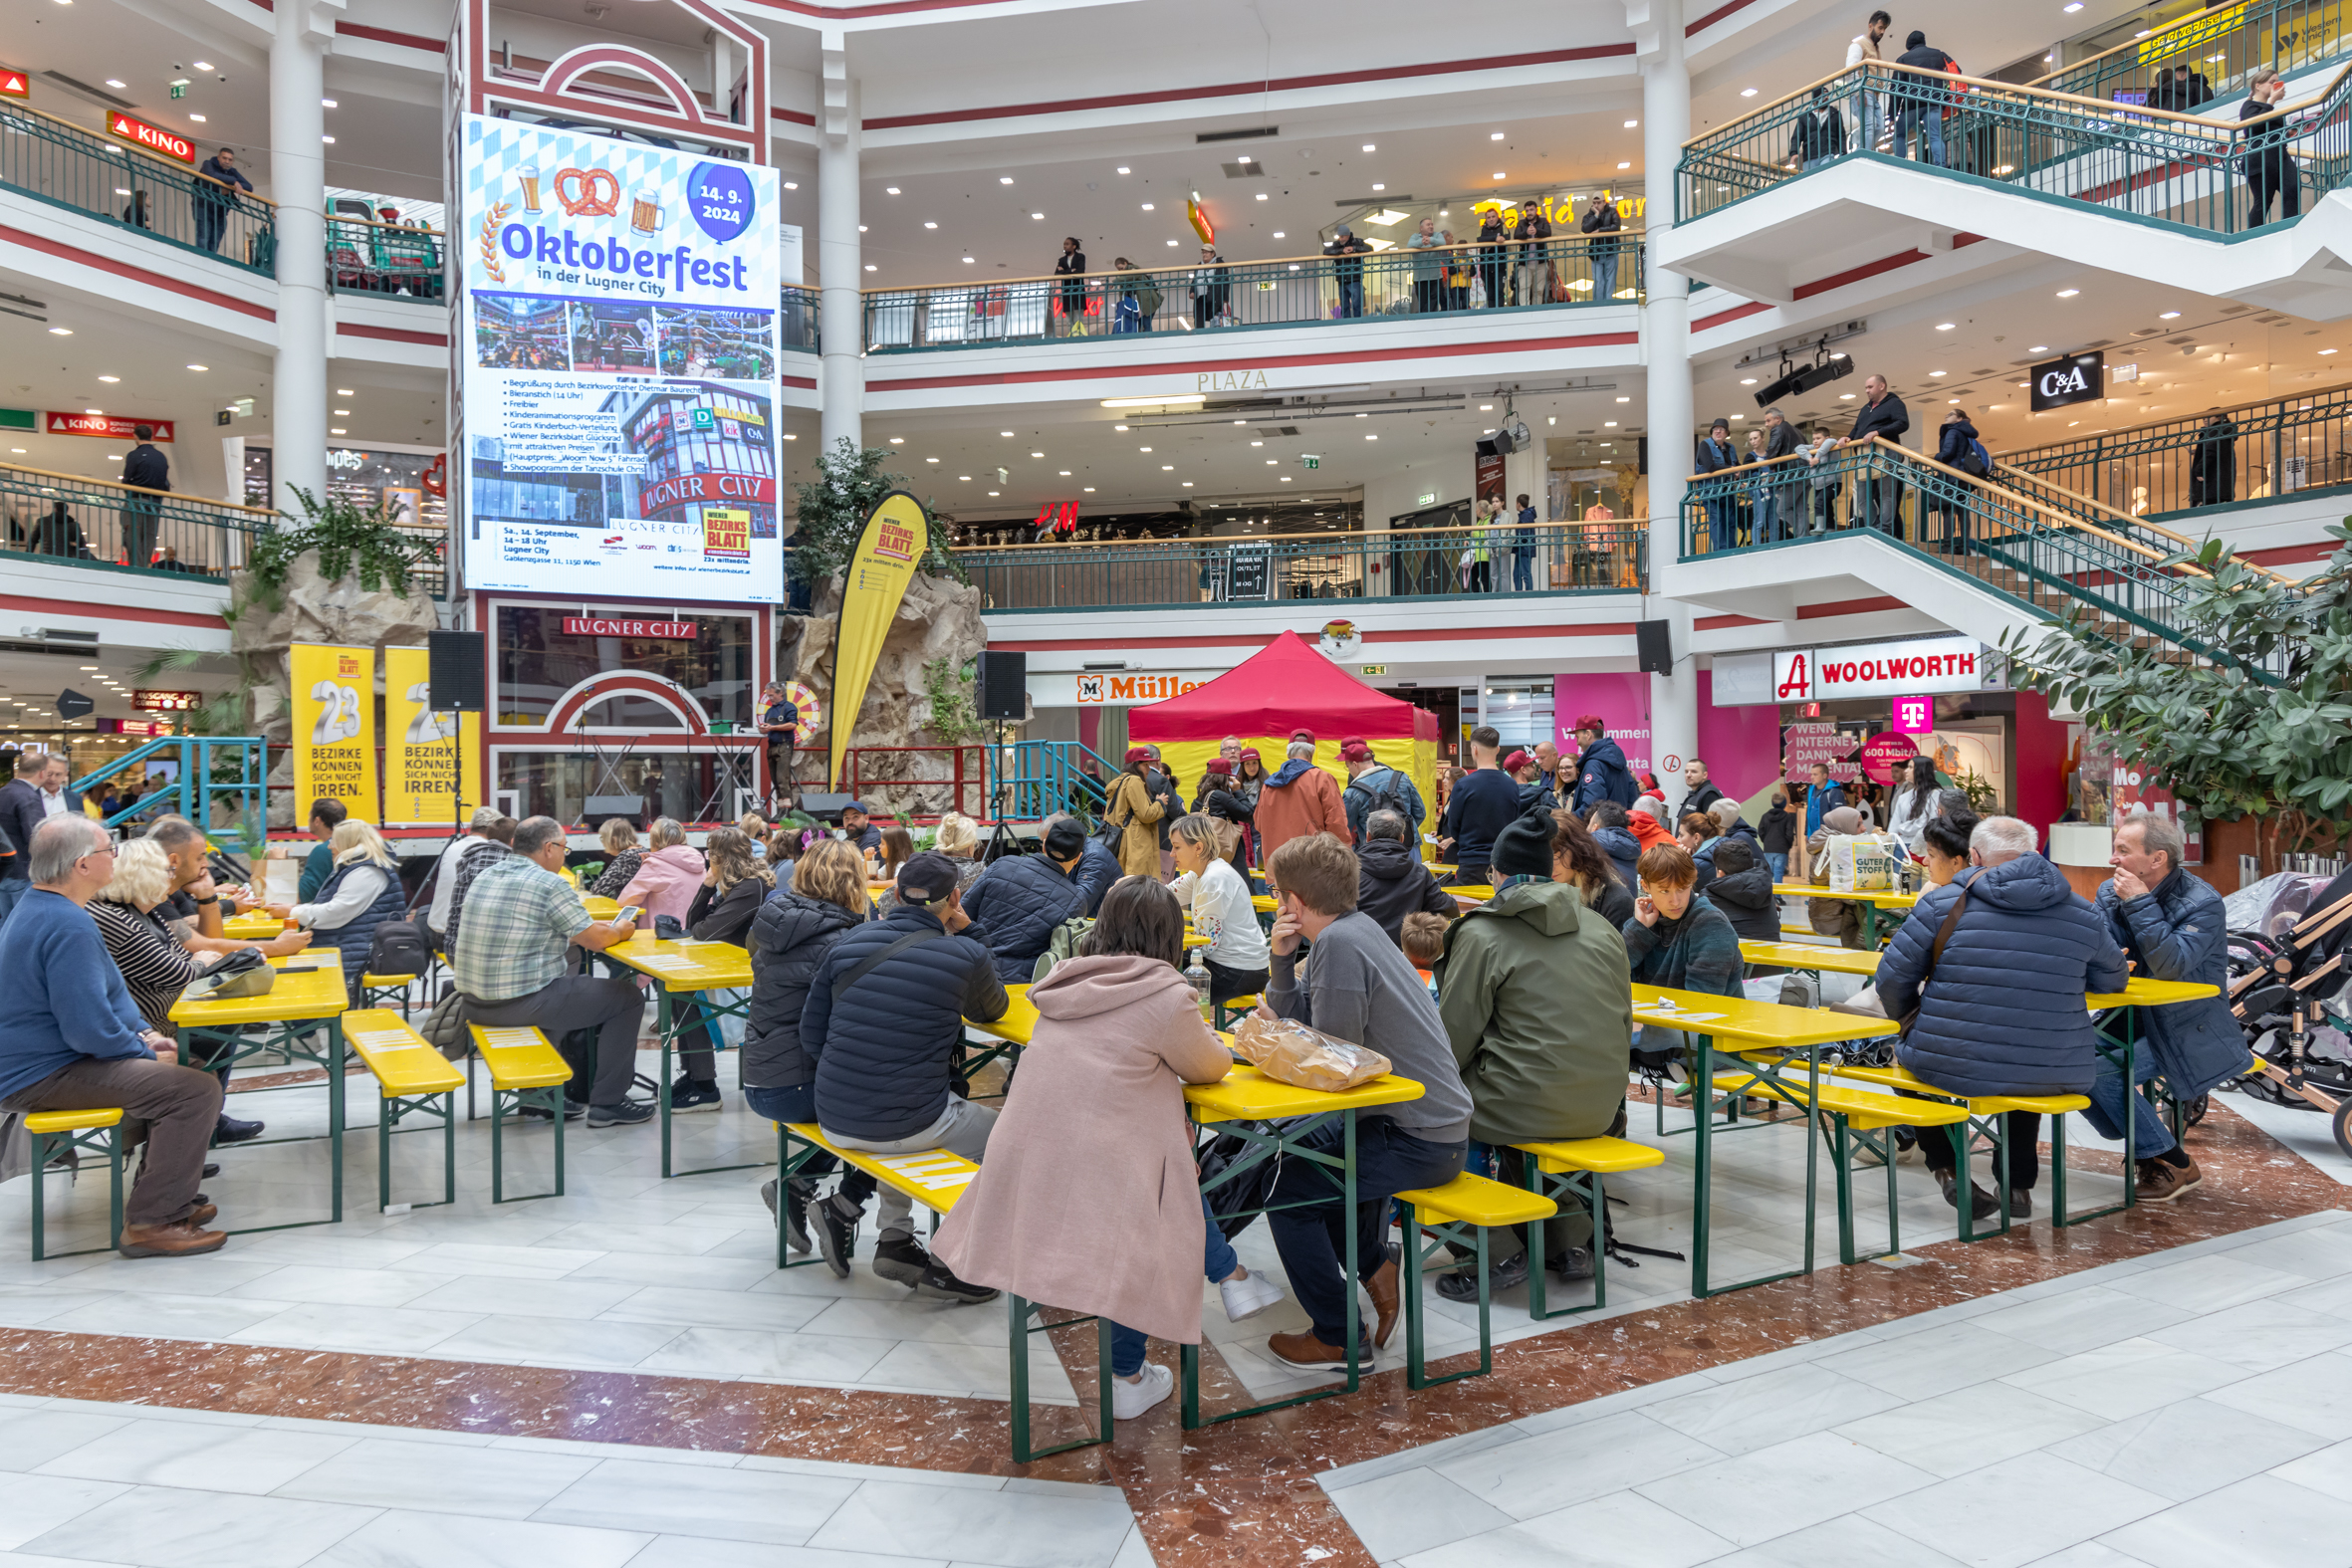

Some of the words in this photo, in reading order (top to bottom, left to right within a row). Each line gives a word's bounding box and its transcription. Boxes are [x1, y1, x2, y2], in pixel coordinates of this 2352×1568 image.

[2301, 16, 2342, 36] Western
[2301, 27, 2331, 44] Union
[138, 124, 188, 155] KINO
[700, 185, 724, 201] 14.
[727, 190, 743, 204] 9.
[702, 205, 741, 224] 2024
[502, 223, 748, 292] Oktoberfest
[537, 266, 552, 280] in
[556, 268, 581, 284] der
[585, 273, 634, 297] Lugner
[638, 281, 666, 298] City
[509, 379, 553, 390] Begrüßung
[554, 380, 576, 389] durch
[577, 381, 637, 391] Bezirksvorsteher
[1197, 370, 1268, 391] PLAZA
[2039, 366, 2088, 397] C&A
[509, 410, 616, 422] Kinderanimationsprogramm
[69, 418, 108, 431] KINO
[534, 422, 617, 433] Kinderbuch-Verteilung
[725, 423, 739, 436] kik
[540, 432, 584, 441] Bezirksblatt
[586, 433, 621, 442] Glücksrad
[646, 478, 705, 510] LUGNER
[719, 476, 762, 498] CITY
[707, 519, 747, 533] BEZIRKS
[880, 524, 914, 541] BEZIRKS
[535, 529, 580, 540] September,
[707, 532, 747, 549] BLATT
[877, 534, 913, 554] BLATT
[504, 546, 533, 555] Lugner
[534, 547, 550, 556] City
[504, 555, 552, 564] Gablenzgasse
[571, 619, 643, 635] LUGNER
[649, 622, 690, 636] CITY
[339, 665, 359, 674] BLATT
[1821, 652, 1975, 684] WOOLWORTH
[1109, 676, 1207, 700] Mülle
[311, 679, 361, 746] 23
[1808, 703, 1817, 716] 7
[1796, 723, 1835, 735] WENN
[1796, 736, 1857, 747] INTERNET
[312, 748, 361, 760] BEZIRKE
[1796, 750, 1832, 761] DANN
[1864, 748, 1884, 757] 600
[1886, 748, 1918, 758] Mbit/s
[312, 759, 361, 772] KÖNNEN
[312, 773, 333, 783] SICH
[312, 784, 362, 796] IRREN.
